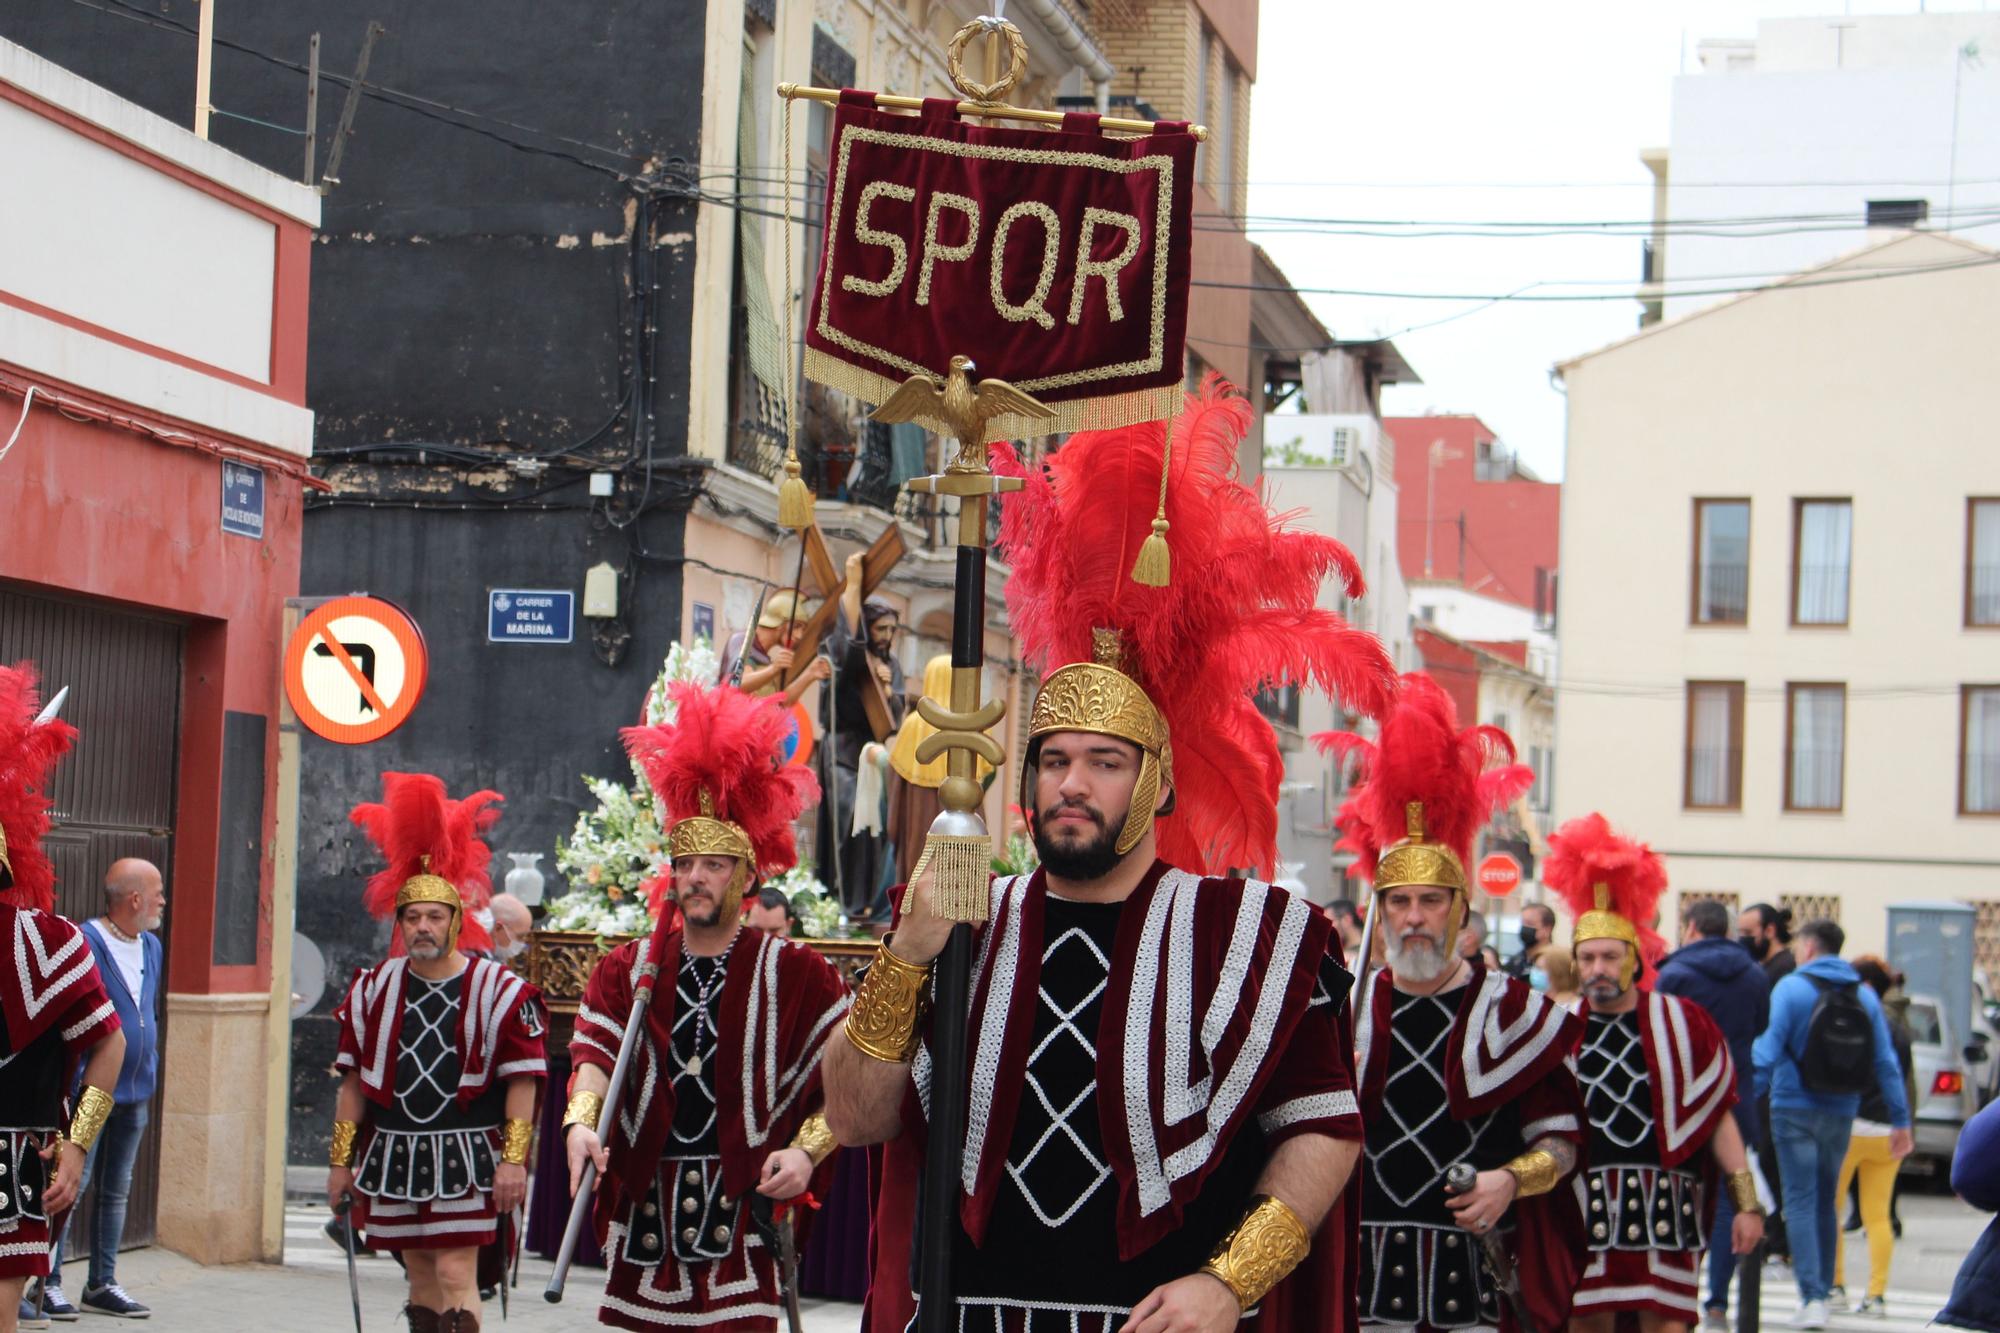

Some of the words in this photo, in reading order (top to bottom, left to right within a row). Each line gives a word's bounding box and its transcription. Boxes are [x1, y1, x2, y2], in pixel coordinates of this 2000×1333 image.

[842, 180, 1141, 331] SPQR
[516, 598, 553, 607] CARRER
[516, 611, 529, 620] DE
[532, 611, 544, 620] LA
[506, 624, 553, 634] MARINA
[1484, 869, 1515, 883] STOP
